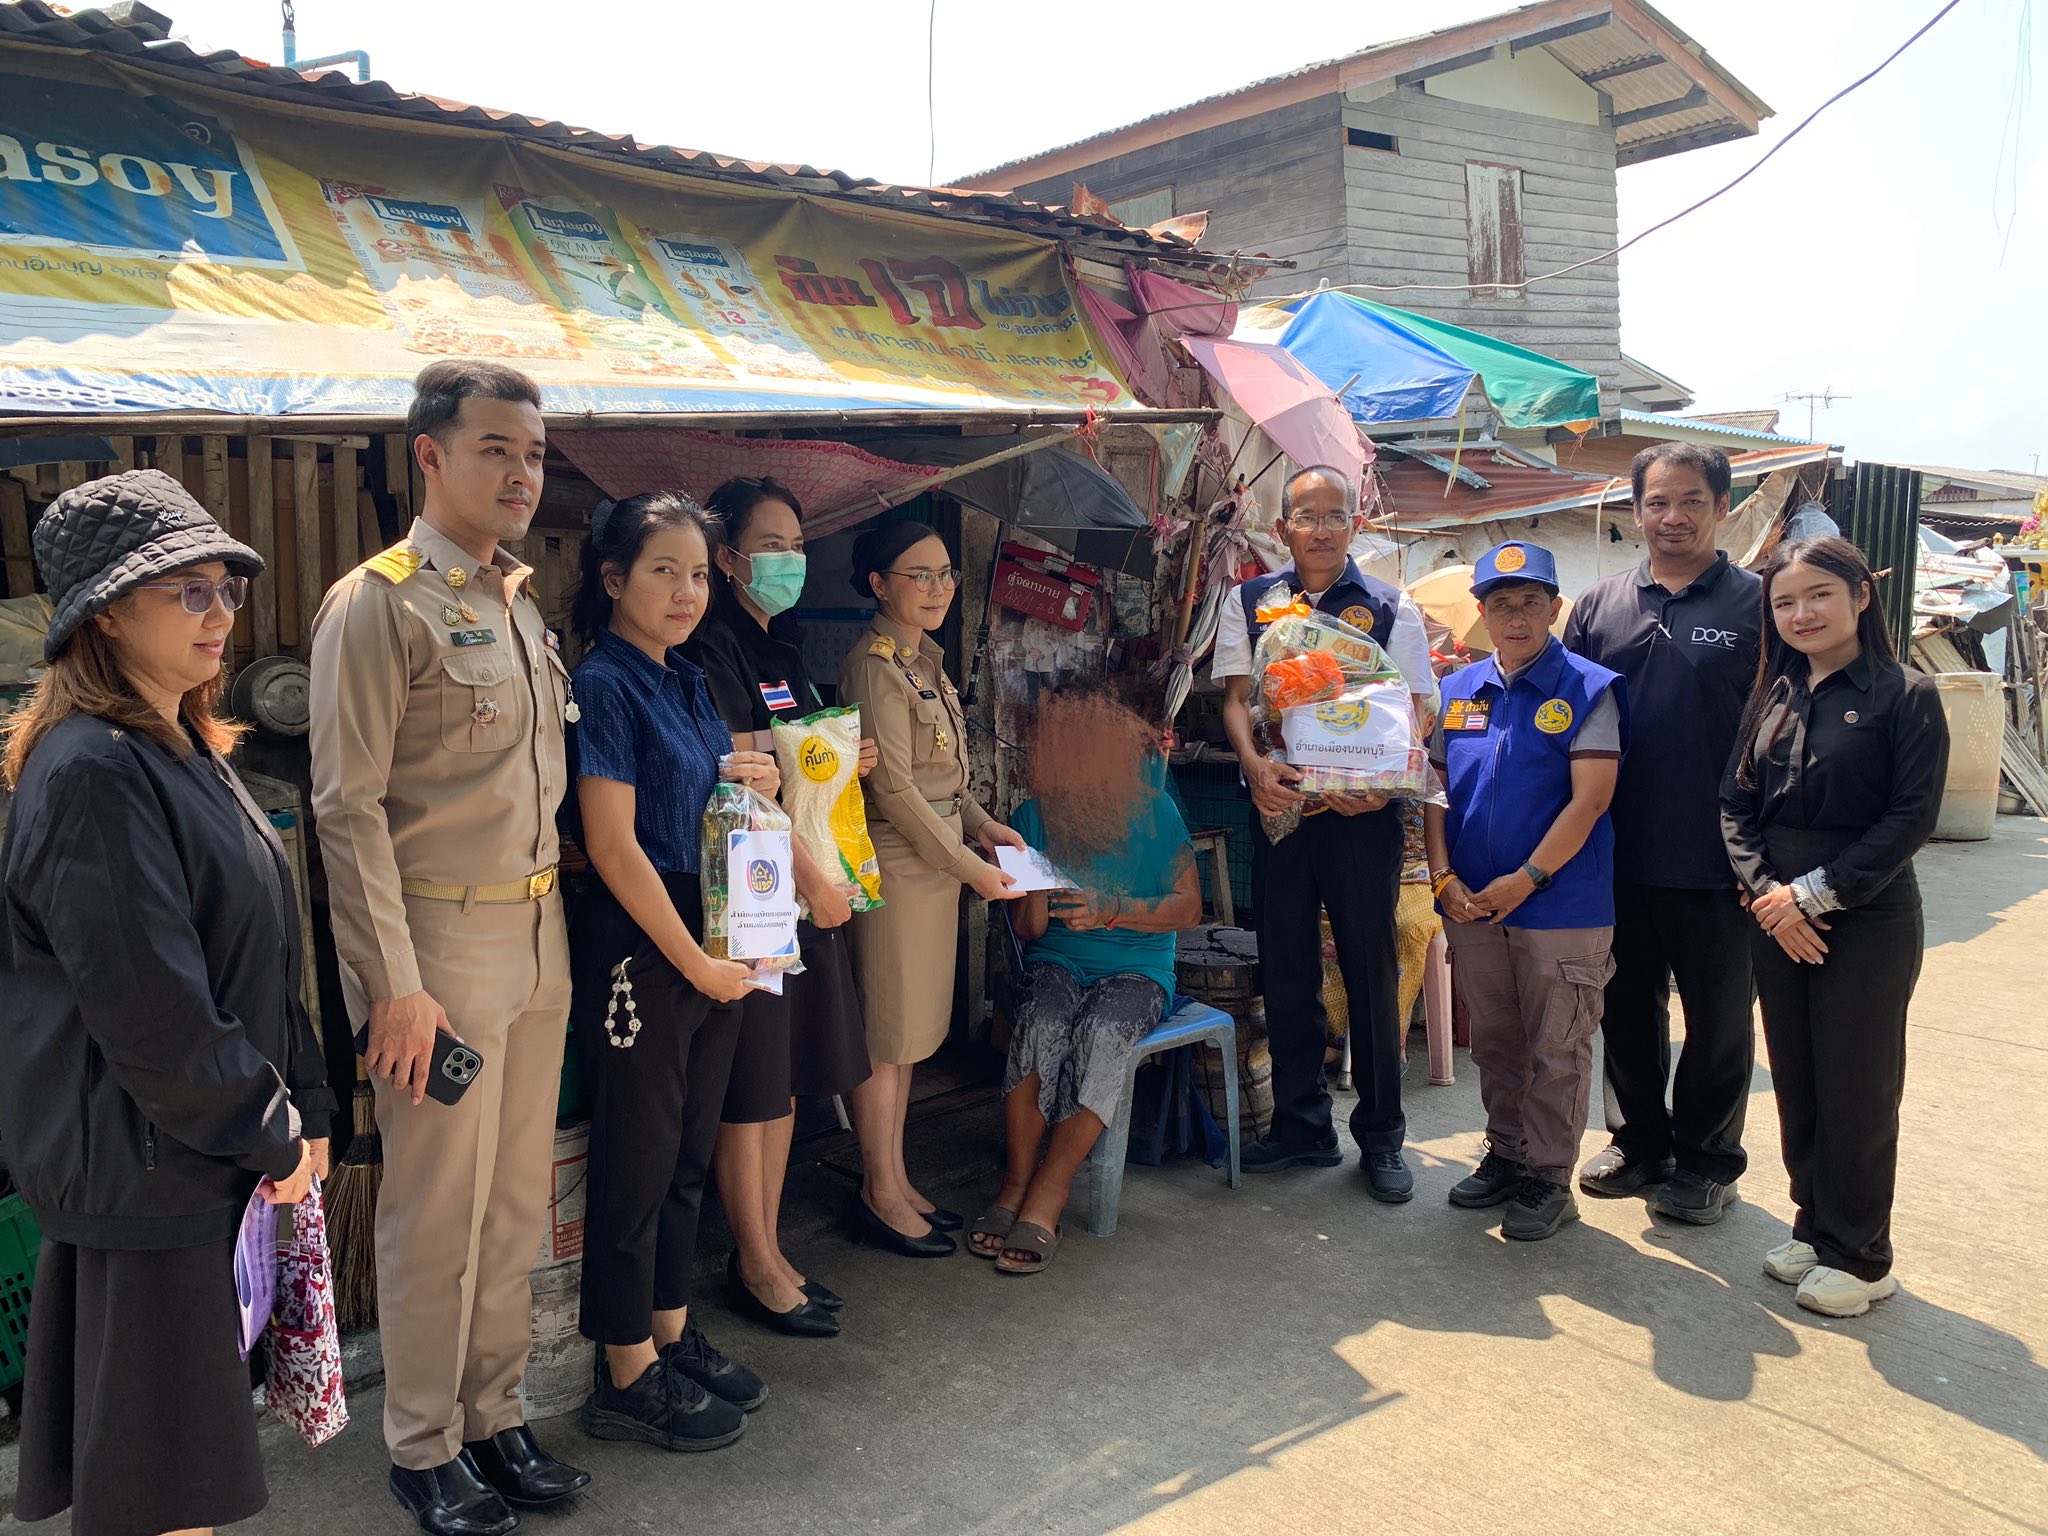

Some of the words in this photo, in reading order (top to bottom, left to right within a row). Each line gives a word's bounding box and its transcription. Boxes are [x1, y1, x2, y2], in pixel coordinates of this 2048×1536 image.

[369, 198, 462, 227] Lactasoy
[526, 207, 603, 236] Lactasoy
[536, 235, 620, 257] SOYMILK
[659, 241, 723, 263] Lactasoy
[671, 263, 739, 282] SOYMILK
[714, 310, 747, 326] 13
[1006, 571, 1062, 600] ตู้จดหมาย
[804, 743, 836, 773] คุ้มค่า
[1295, 739, 1385, 763] อำเภอเมืองนนทบุรี
